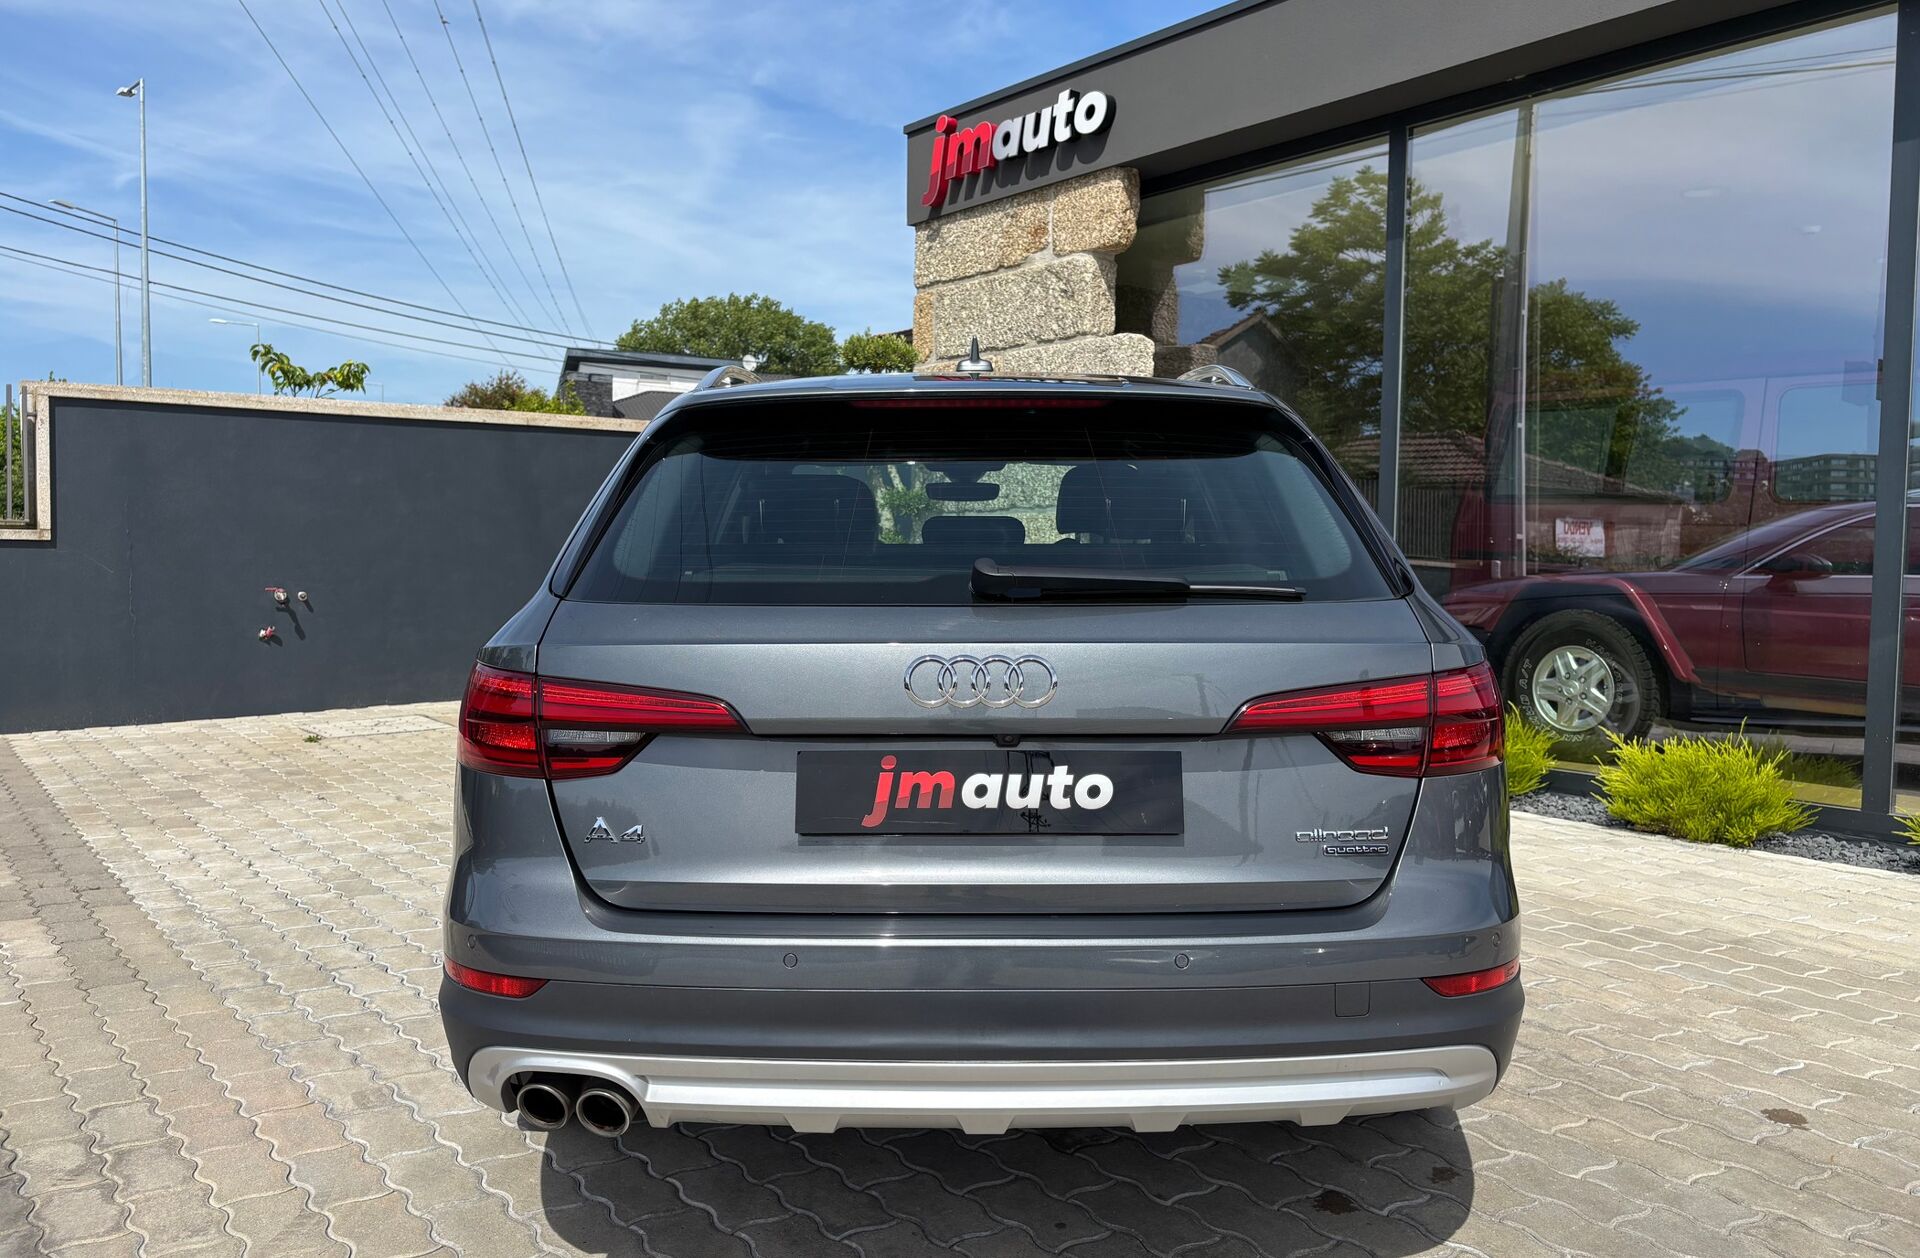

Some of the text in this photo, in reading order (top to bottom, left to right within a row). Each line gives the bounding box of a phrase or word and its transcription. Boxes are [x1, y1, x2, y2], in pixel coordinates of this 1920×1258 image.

[921, 88, 1108, 207] jmauto
[861, 755, 1114, 828] jmauto
[584, 816, 645, 844] A4
[1296, 826, 1388, 842] allroad
[1326, 846, 1387, 856] quattro
